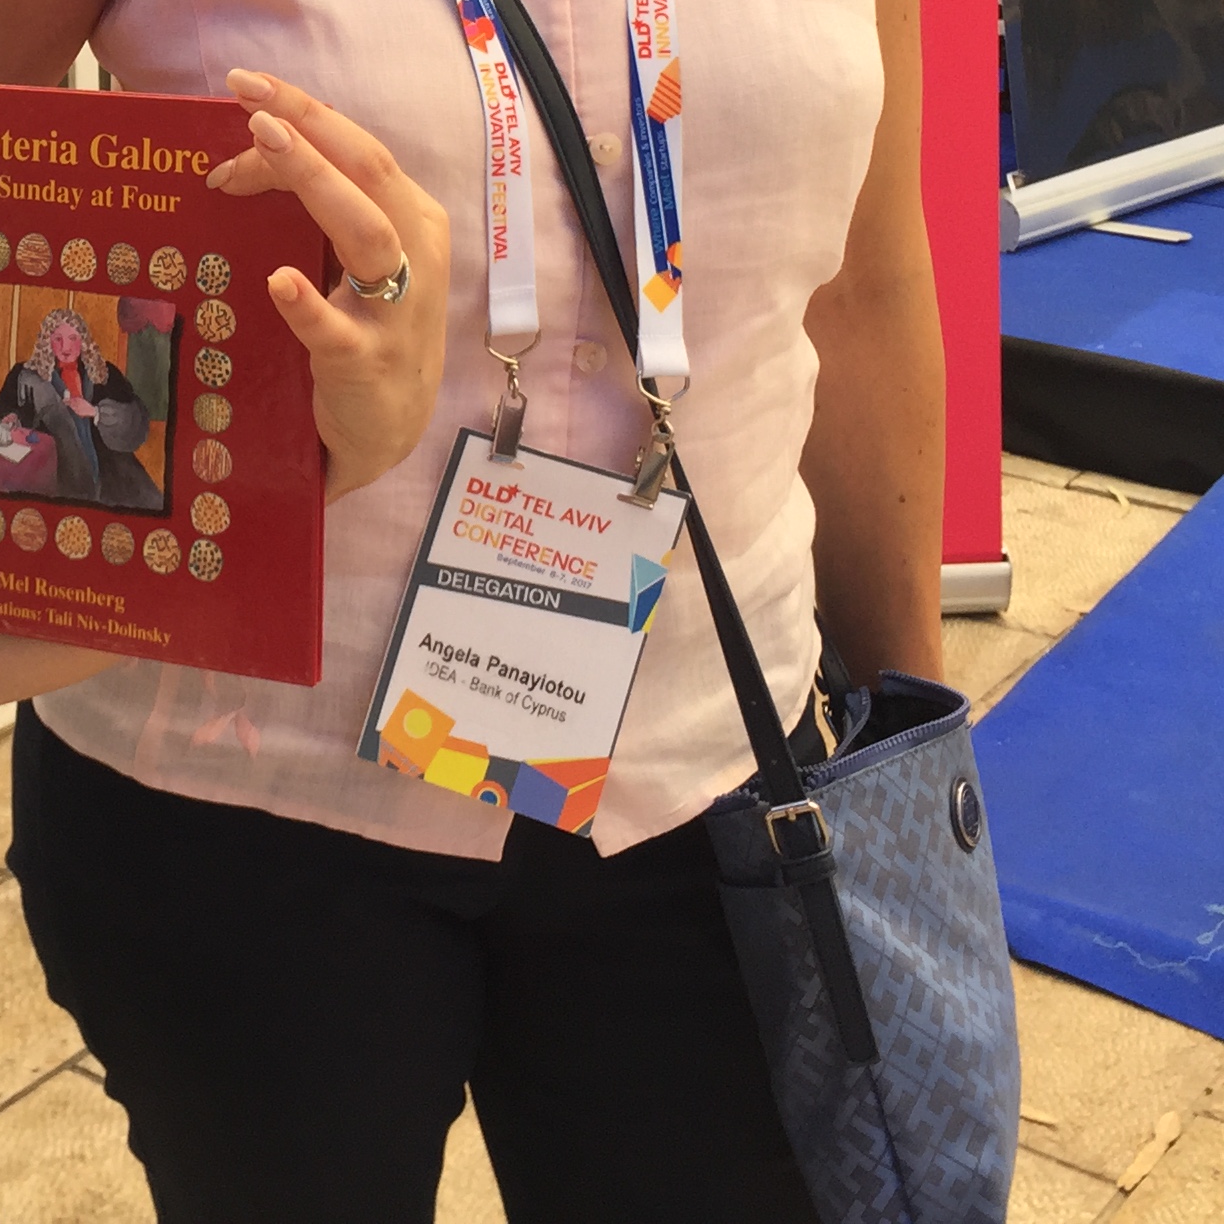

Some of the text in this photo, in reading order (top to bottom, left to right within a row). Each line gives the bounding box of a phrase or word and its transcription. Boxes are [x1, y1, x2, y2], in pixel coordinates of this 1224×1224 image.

[638, 22, 652, 59] DLD
[494, 62, 522, 176] DLD TEL AVIV
[90, 132, 210, 176] Galore
[479, 63, 509, 264] INNOVATION FESTIVAL
[90, 185, 114, 208] at
[121, 184, 181, 213] Four
[660, 173, 675, 211] Meet
[459, 497, 535, 537] DIGITAL
[466, 477, 612, 535] DLD TEL AVIV
[453, 519, 598, 580] CONFERENCE
[437, 568, 561, 610] DELEGATION
[496, 553, 546, 576] September
[570, 577, 593, 591] 2017
[34, 576, 126, 613] Rosenberg
[45, 607, 73, 627] Tali
[77, 612, 172, 647] Niv-Dolinsky
[418, 632, 587, 705] Angela Panayiotou
[469, 676, 502, 700] Bank
[505, 690, 521, 705] of
[521, 694, 567, 723] Cyprus
